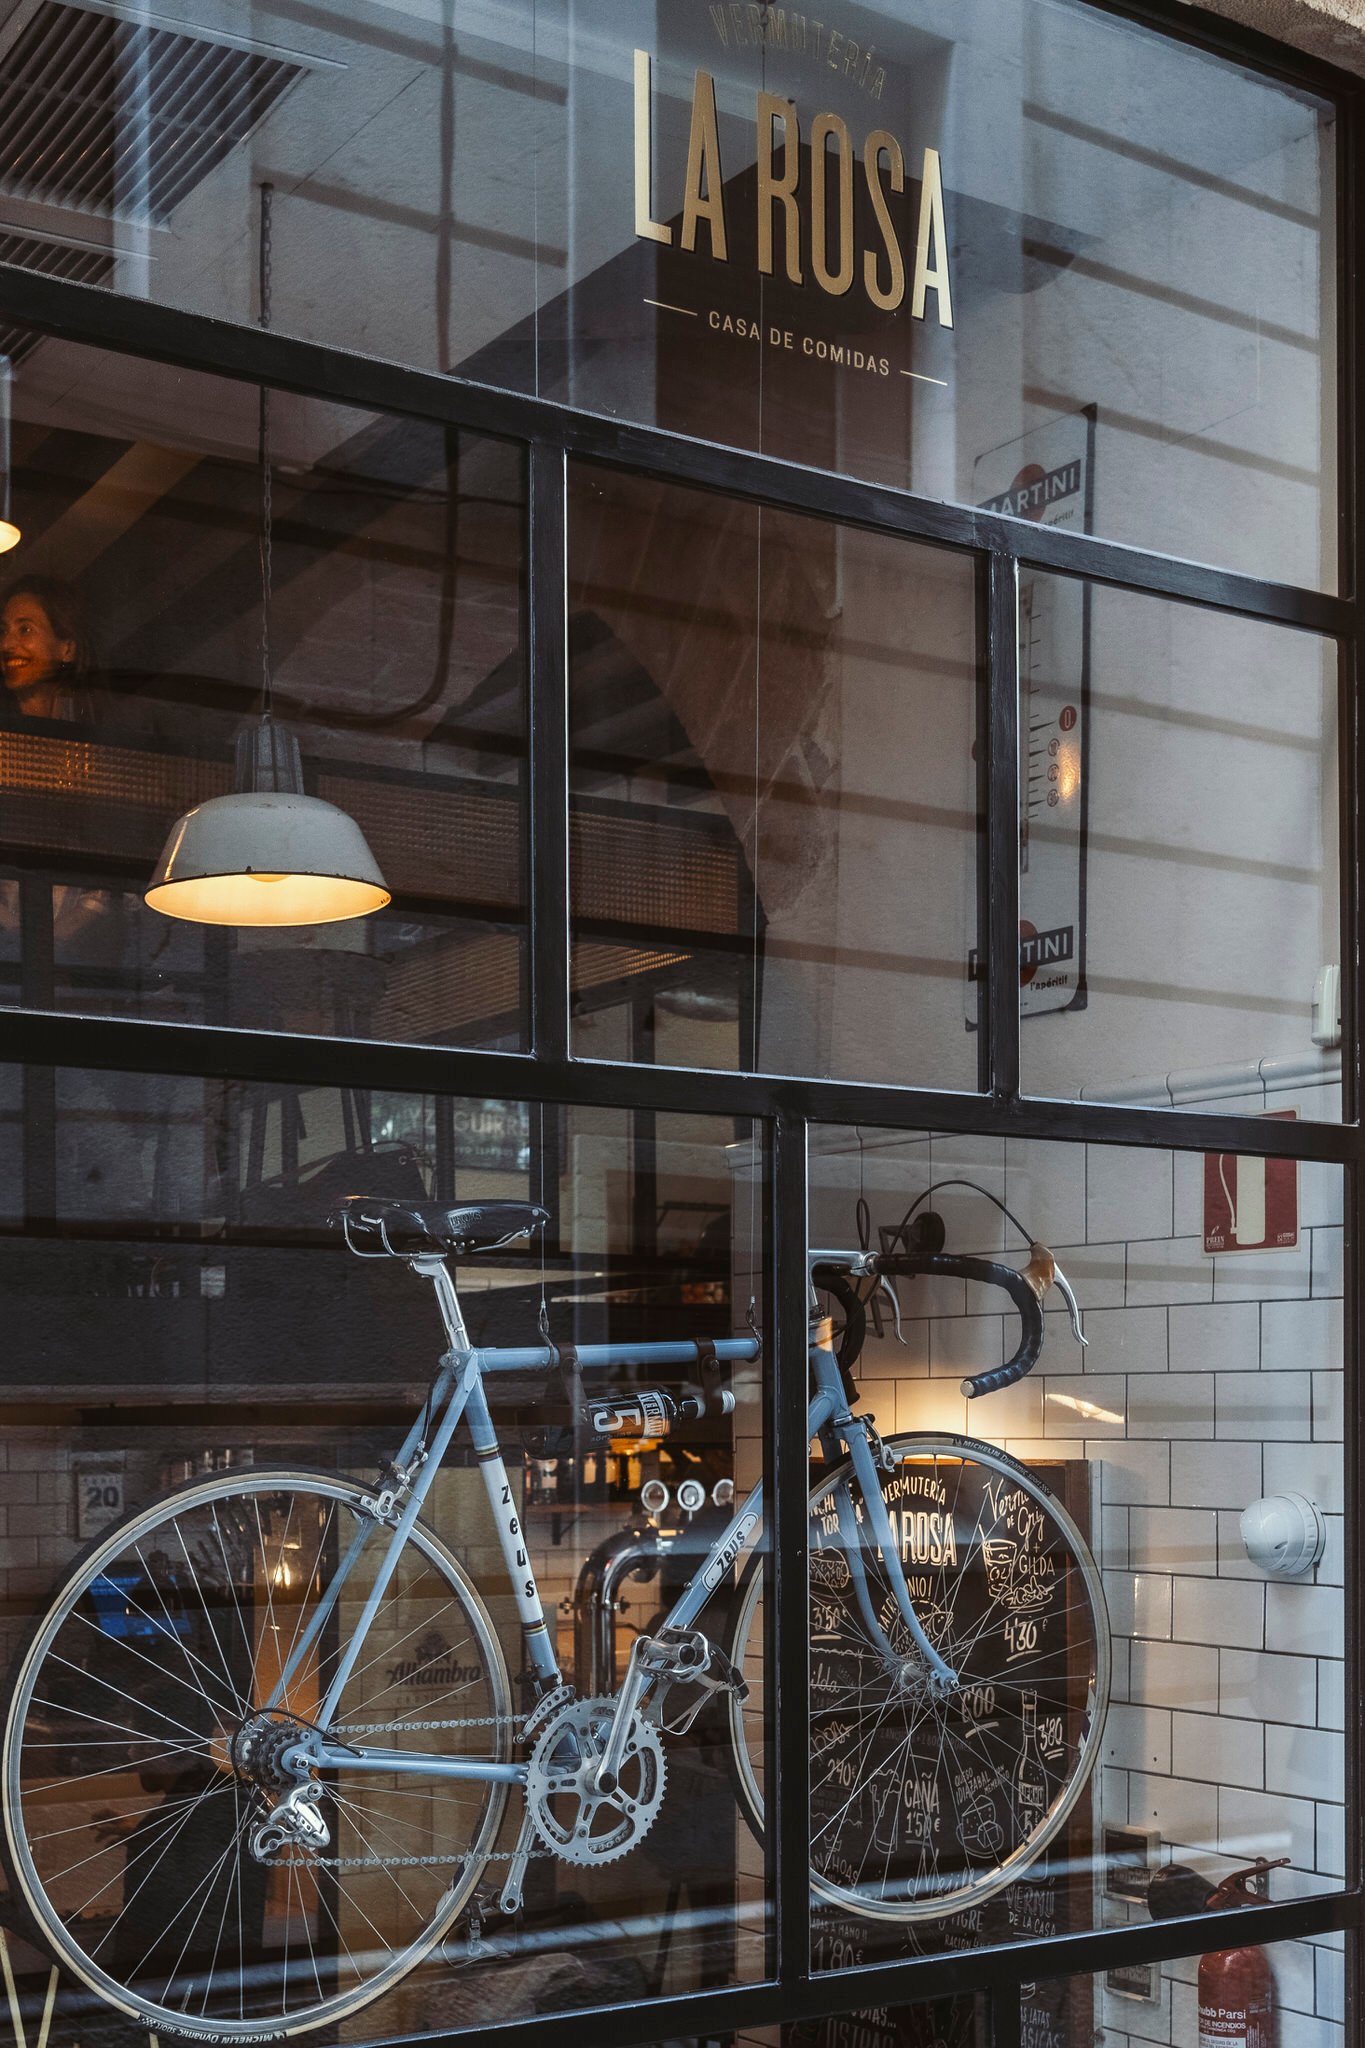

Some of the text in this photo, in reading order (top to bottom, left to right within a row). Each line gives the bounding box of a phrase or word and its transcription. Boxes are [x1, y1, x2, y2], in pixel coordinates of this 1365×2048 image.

[709, 4, 888, 100] VERMUTERÍA
[633, 48, 954, 329] LA ROSA
[708, 311, 891, 377] CASA DE COMIDAS
[963, 1440, 1001, 1458] MICHELIN
[87, 1486, 119, 1508] 20
[881, 1475, 946, 1506] VERMUTERÍA
[902, 1511, 958, 1567] ROSA
[1019, 1554, 1056, 1577] GILDA
[385, 1659, 481, 1688] Alhambra
[810, 1662, 840, 1694] ilda
[1038, 1717, 1063, 1751] 3'80
[904, 1772, 940, 1815] CAÑA
[1009, 1911, 1056, 1937] DE LA CASA
[1218, 2008, 1247, 2020] Parsi
[221, 2033, 274, 2046] MICHELIN
